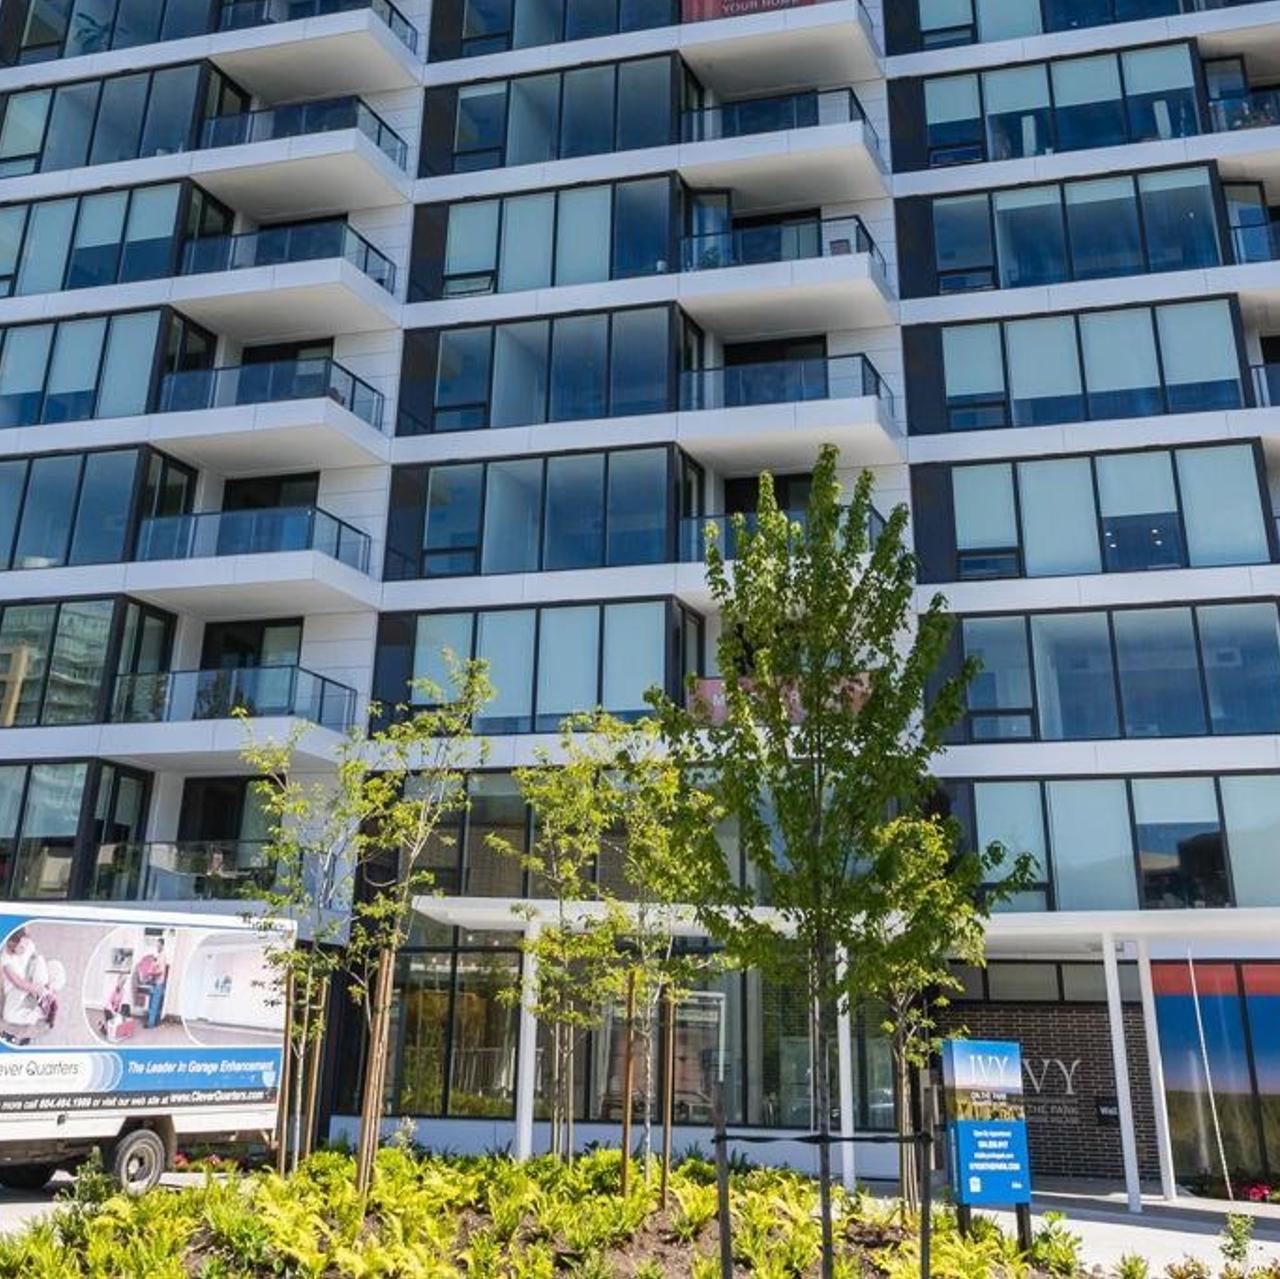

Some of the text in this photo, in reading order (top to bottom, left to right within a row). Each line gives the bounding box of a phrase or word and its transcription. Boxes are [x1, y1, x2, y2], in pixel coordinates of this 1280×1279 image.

[722, 1, 758, 15] YOUR
[26, 1060, 79, 1077] Quarters
[128, 1061, 145, 1073] The
[146, 1060, 177, 1073] Leader
[188, 1060, 219, 1075] Garage
